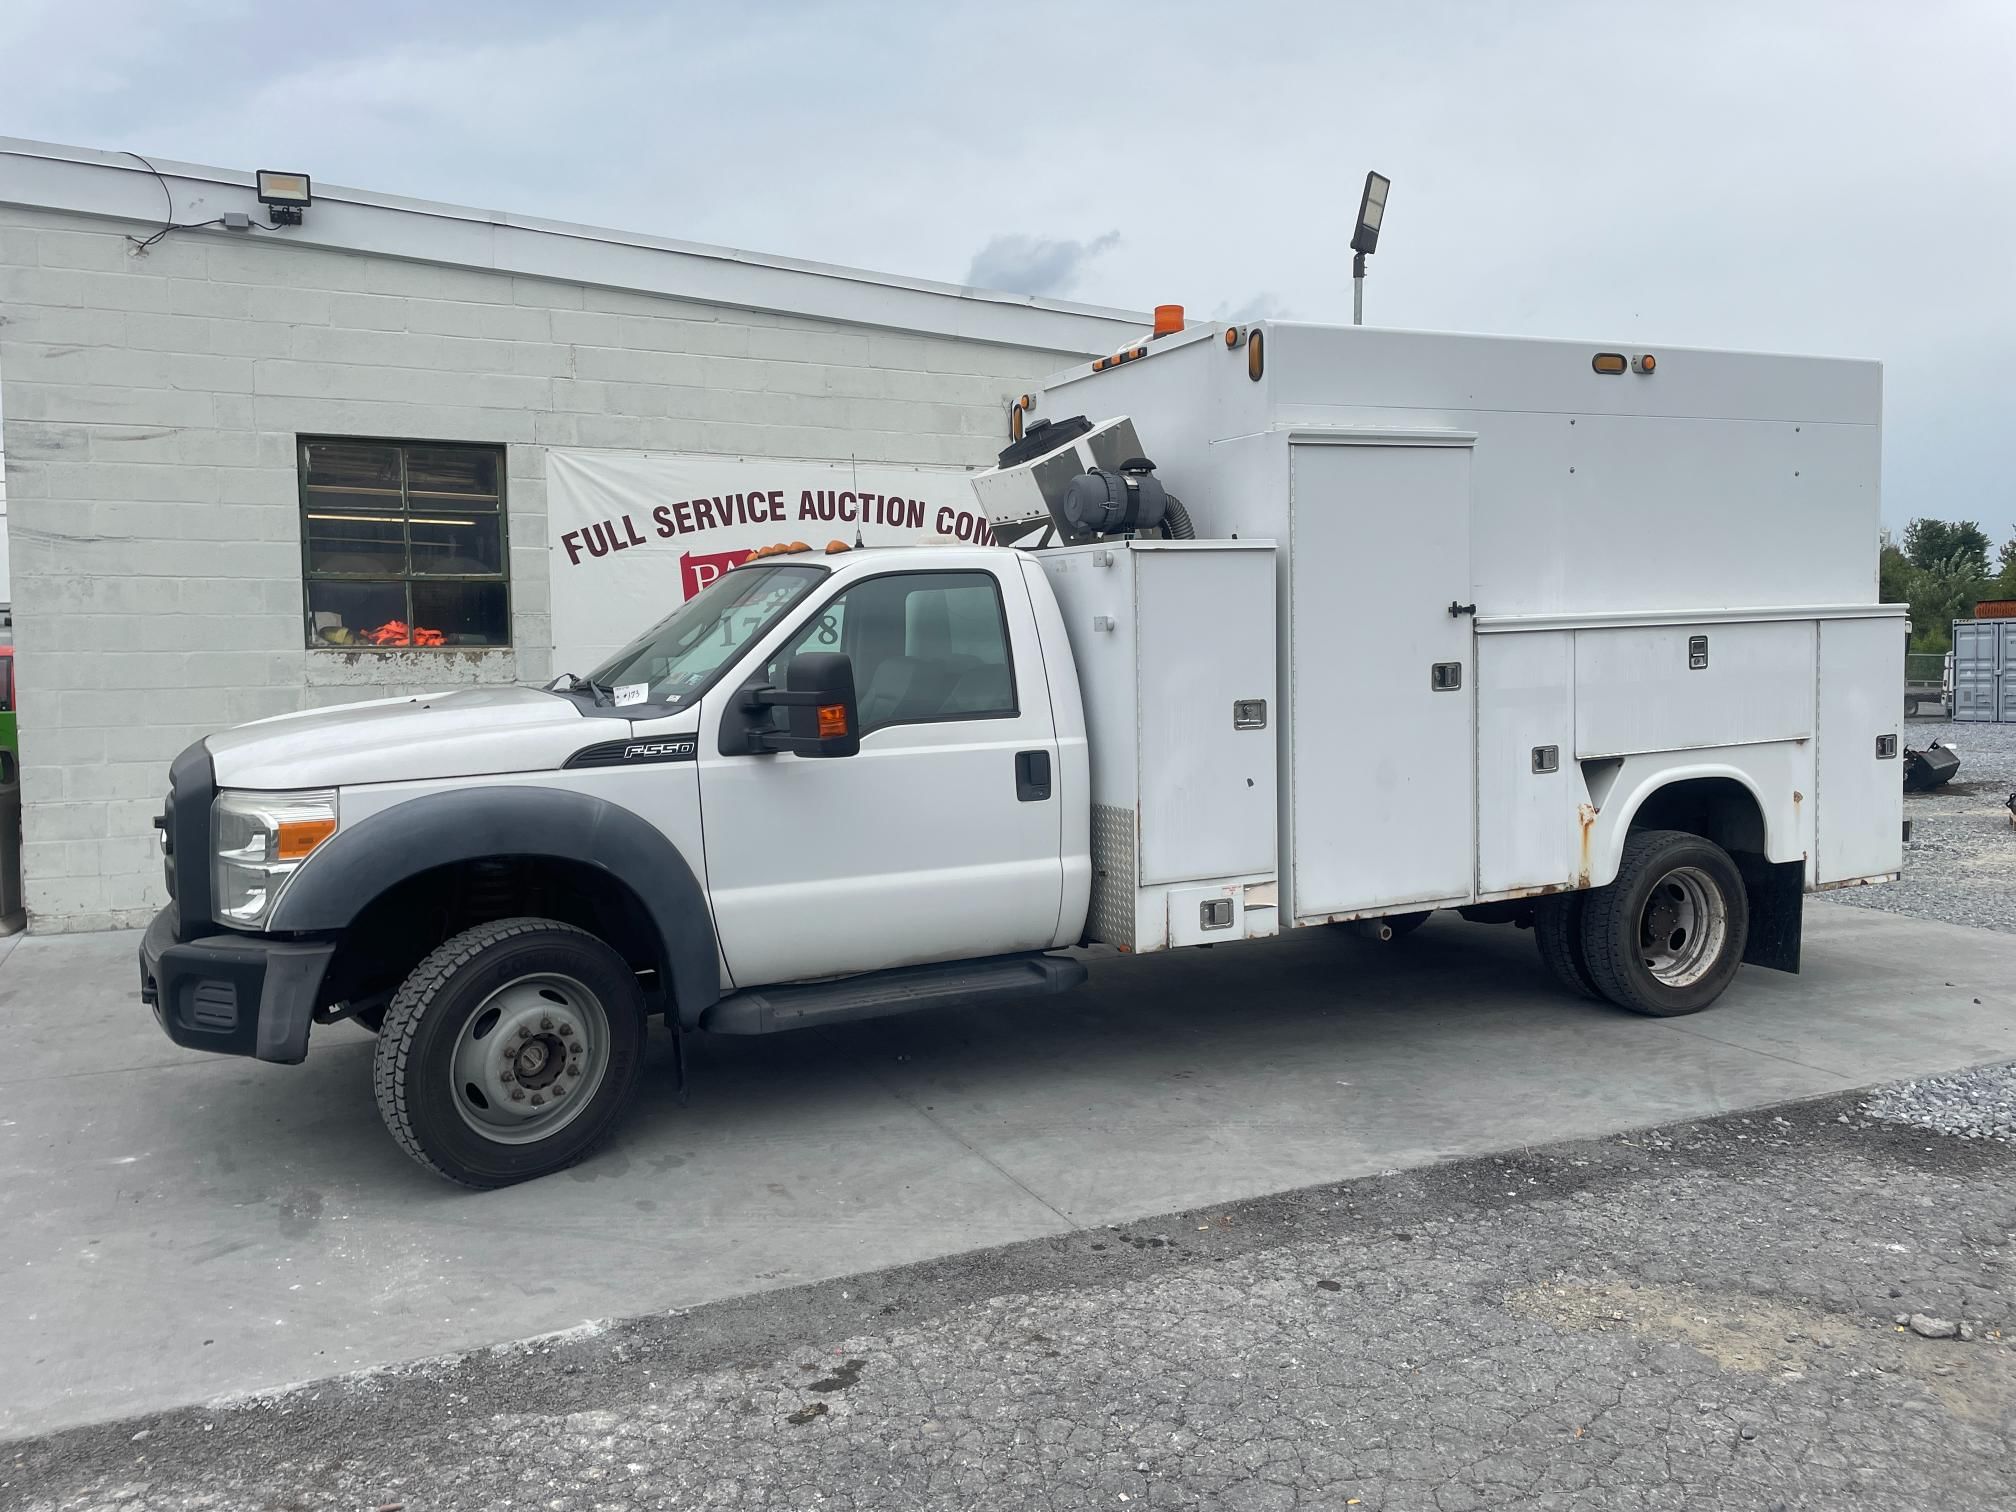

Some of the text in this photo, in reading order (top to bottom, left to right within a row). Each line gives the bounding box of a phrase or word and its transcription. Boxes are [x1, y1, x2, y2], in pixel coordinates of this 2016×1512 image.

[561, 515, 646, 565] FULL
[653, 490, 786, 538] SERVICE
[798, 490, 925, 528] AUCTION
